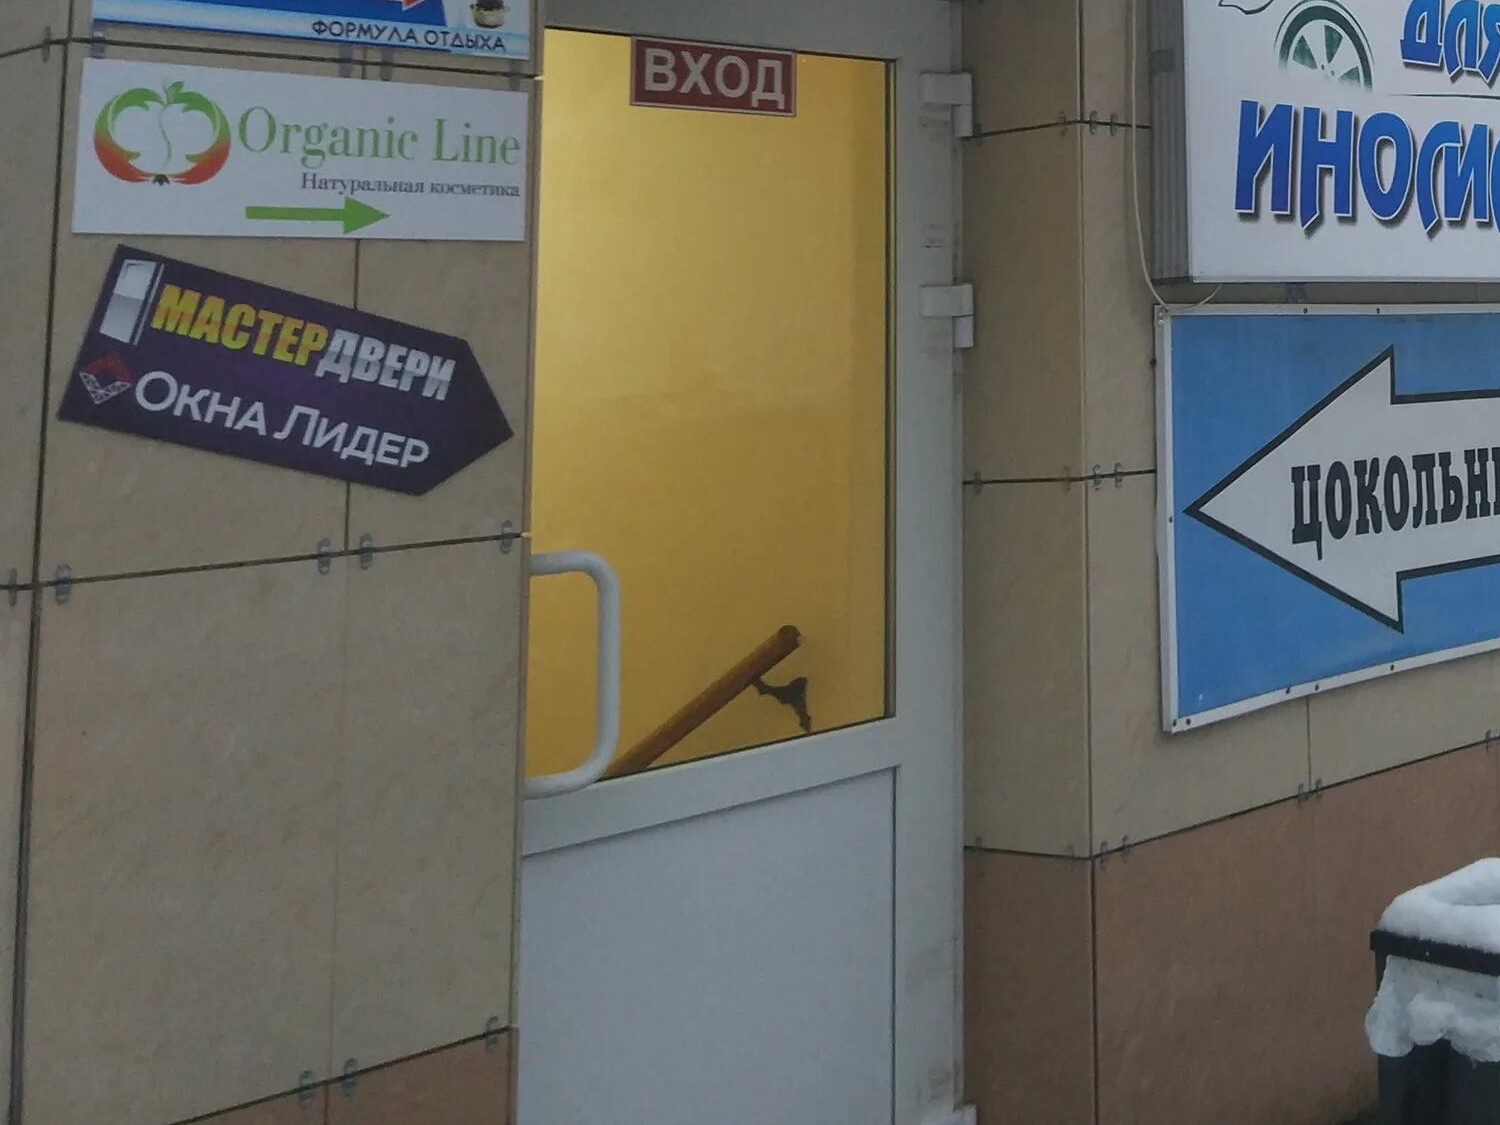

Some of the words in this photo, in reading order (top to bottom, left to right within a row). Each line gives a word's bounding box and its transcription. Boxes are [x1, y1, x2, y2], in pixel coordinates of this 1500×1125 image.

[311, 19, 418, 46] ФОРМУЛА
[424, 28, 506, 53] ОТДЫХА
[644, 47, 786, 110] ВХОД
[238, 105, 418, 168] Organic
[433, 118, 521, 165] Line
[301, 172, 424, 196] Натуральная
[429, 180, 520, 198] косметика
